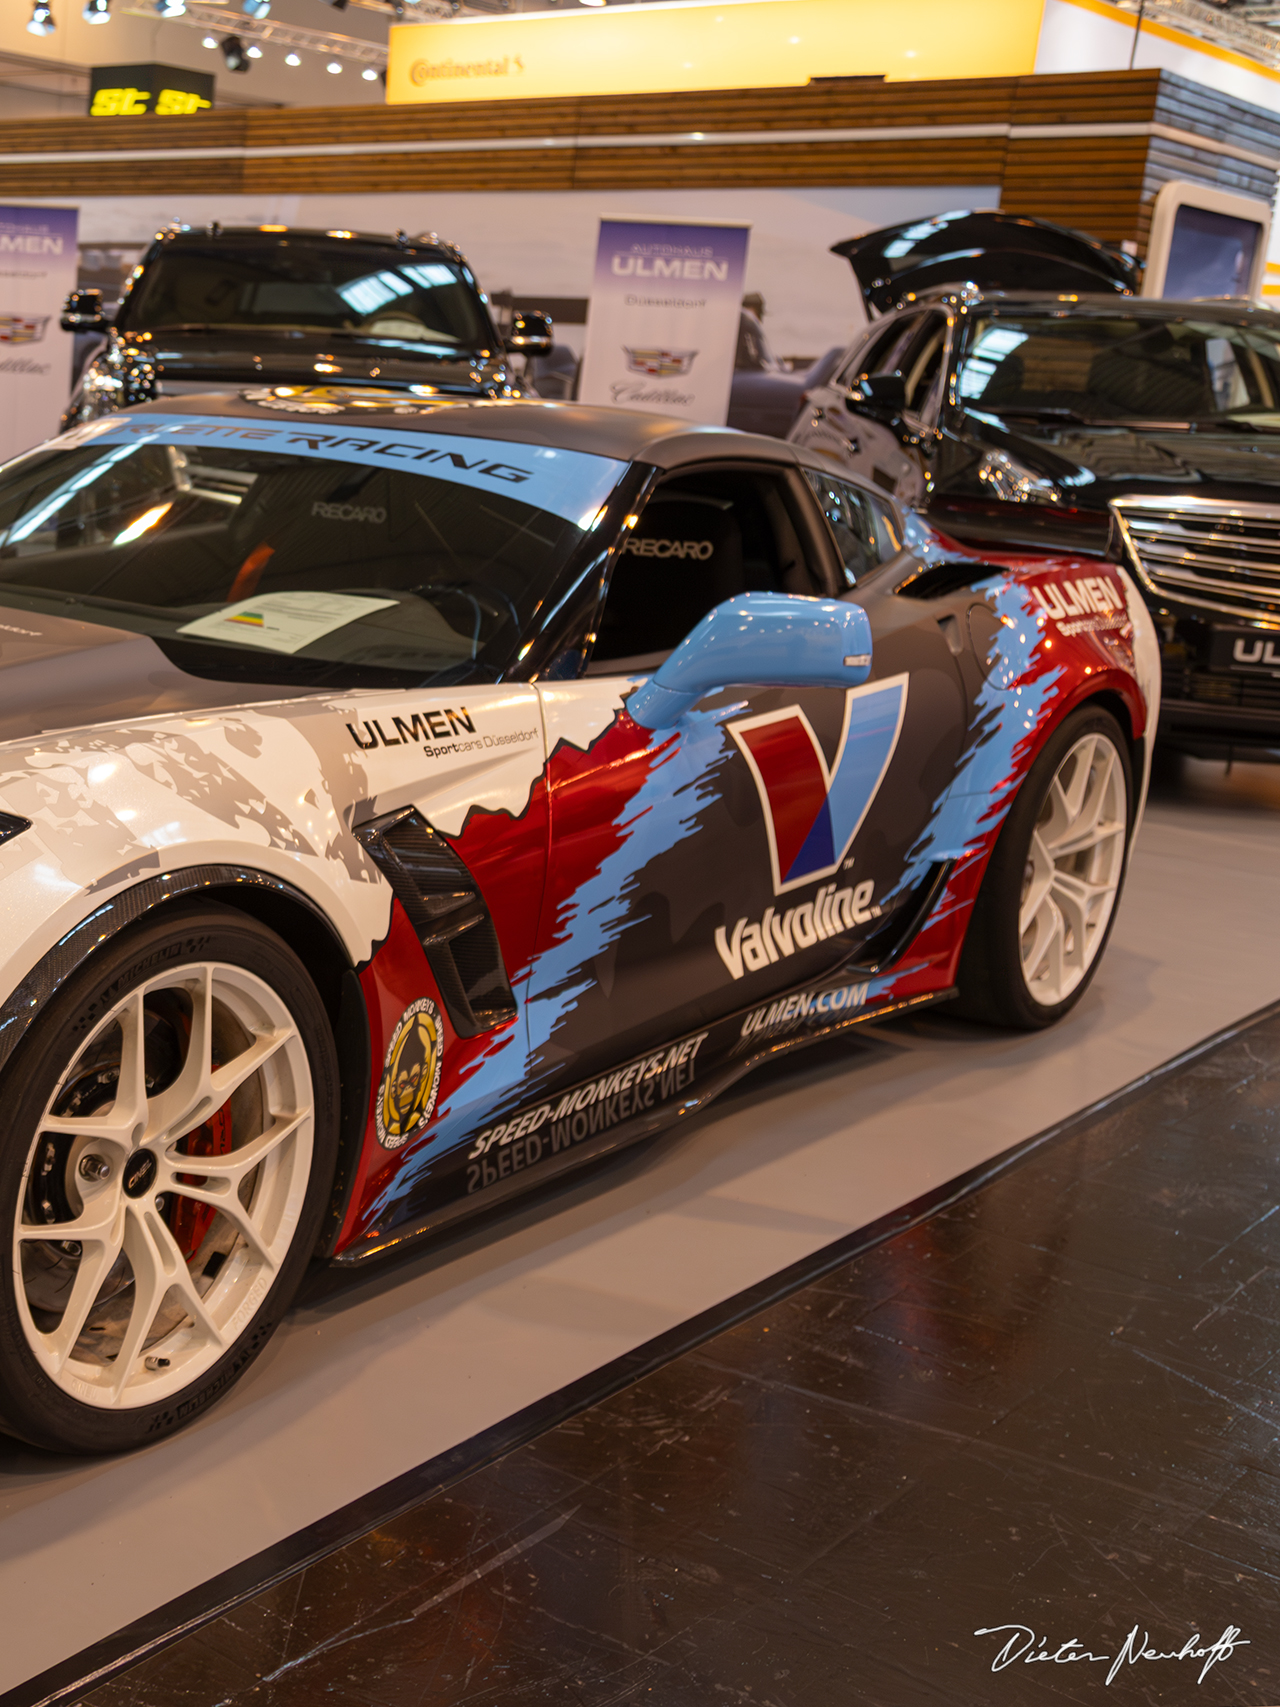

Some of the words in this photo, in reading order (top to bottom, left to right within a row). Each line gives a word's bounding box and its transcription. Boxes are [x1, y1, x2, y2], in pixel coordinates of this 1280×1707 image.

[410, 57, 509, 87] Continental
[611, 255, 729, 281] ULMEN
[286, 431, 535, 484] RACING
[311, 501, 387, 524] RECARO
[622, 538, 714, 560] RECARO
[1031, 576, 1123, 620] ULMEN
[346, 706, 477, 750] ULMEN
[423, 737, 484, 759] Sportcars
[483, 728, 540, 749] Düsseldorf
[715, 879, 875, 980] Valvoline
[117, 942, 183, 988] MICHELIN
[741, 982, 869, 1037] ULMEN.COM
[468, 1032, 710, 1160] SPEED-MONKEYS.NET
[231, 1276, 269, 1331] FORGED
